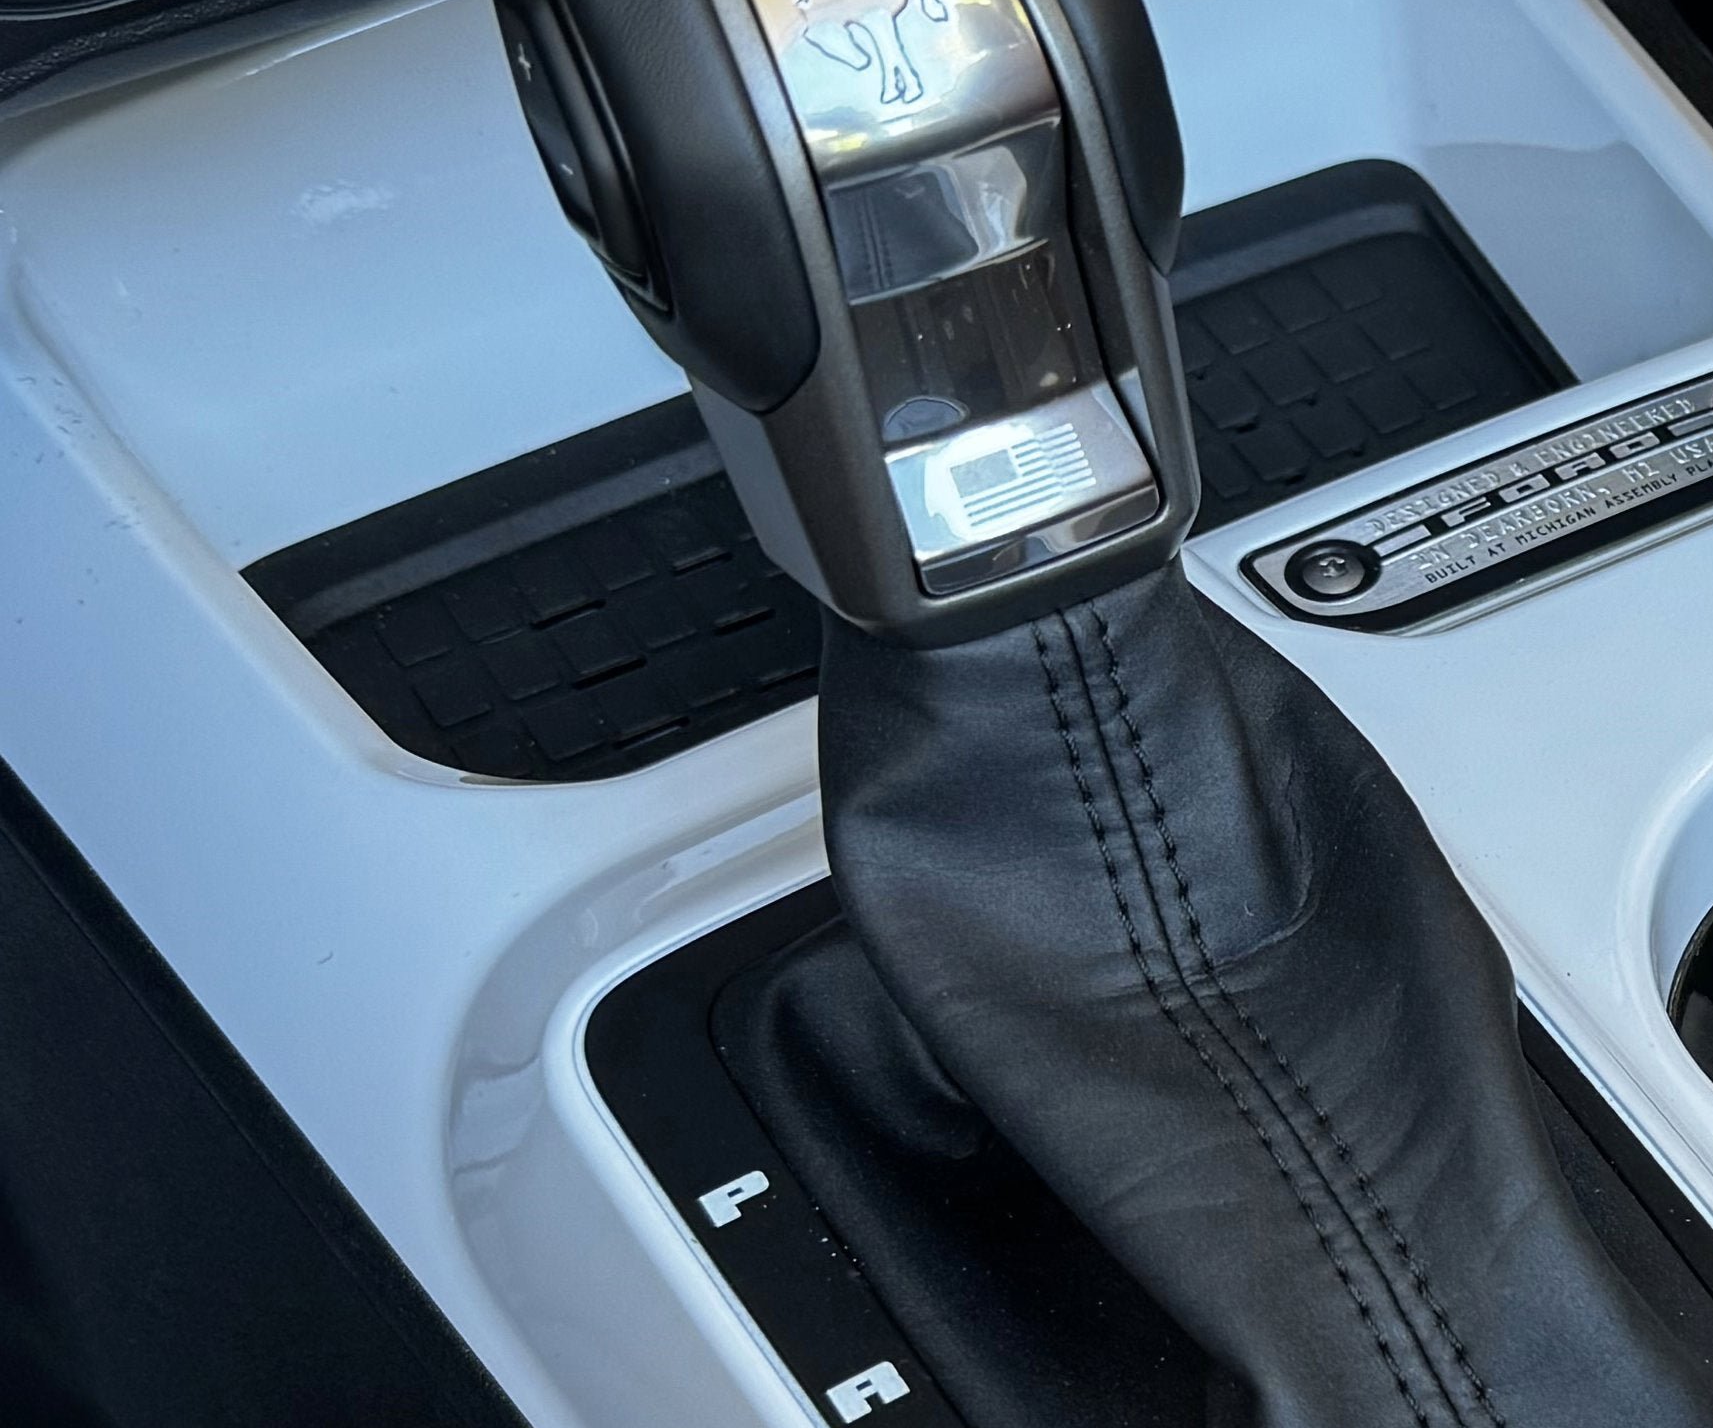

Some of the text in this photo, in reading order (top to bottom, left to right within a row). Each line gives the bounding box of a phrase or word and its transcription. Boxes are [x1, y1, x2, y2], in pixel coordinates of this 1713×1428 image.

[1364, 470, 1500, 538] DESIGNED
[1533, 398, 1697, 466] ENGINEERED
[1409, 544, 1450, 571] IN
[1459, 484, 1612, 549] DEARBORN,
[1621, 462, 1661, 484] MI
[1441, 431, 1661, 528] FORD
[1424, 554, 1476, 584] BUILT
[1486, 541, 1508, 559] AT
[1514, 507, 1597, 546] MICHIGAN
[1604, 473, 1679, 510] ASSEMBLY
[698, 1170, 770, 1228] P
